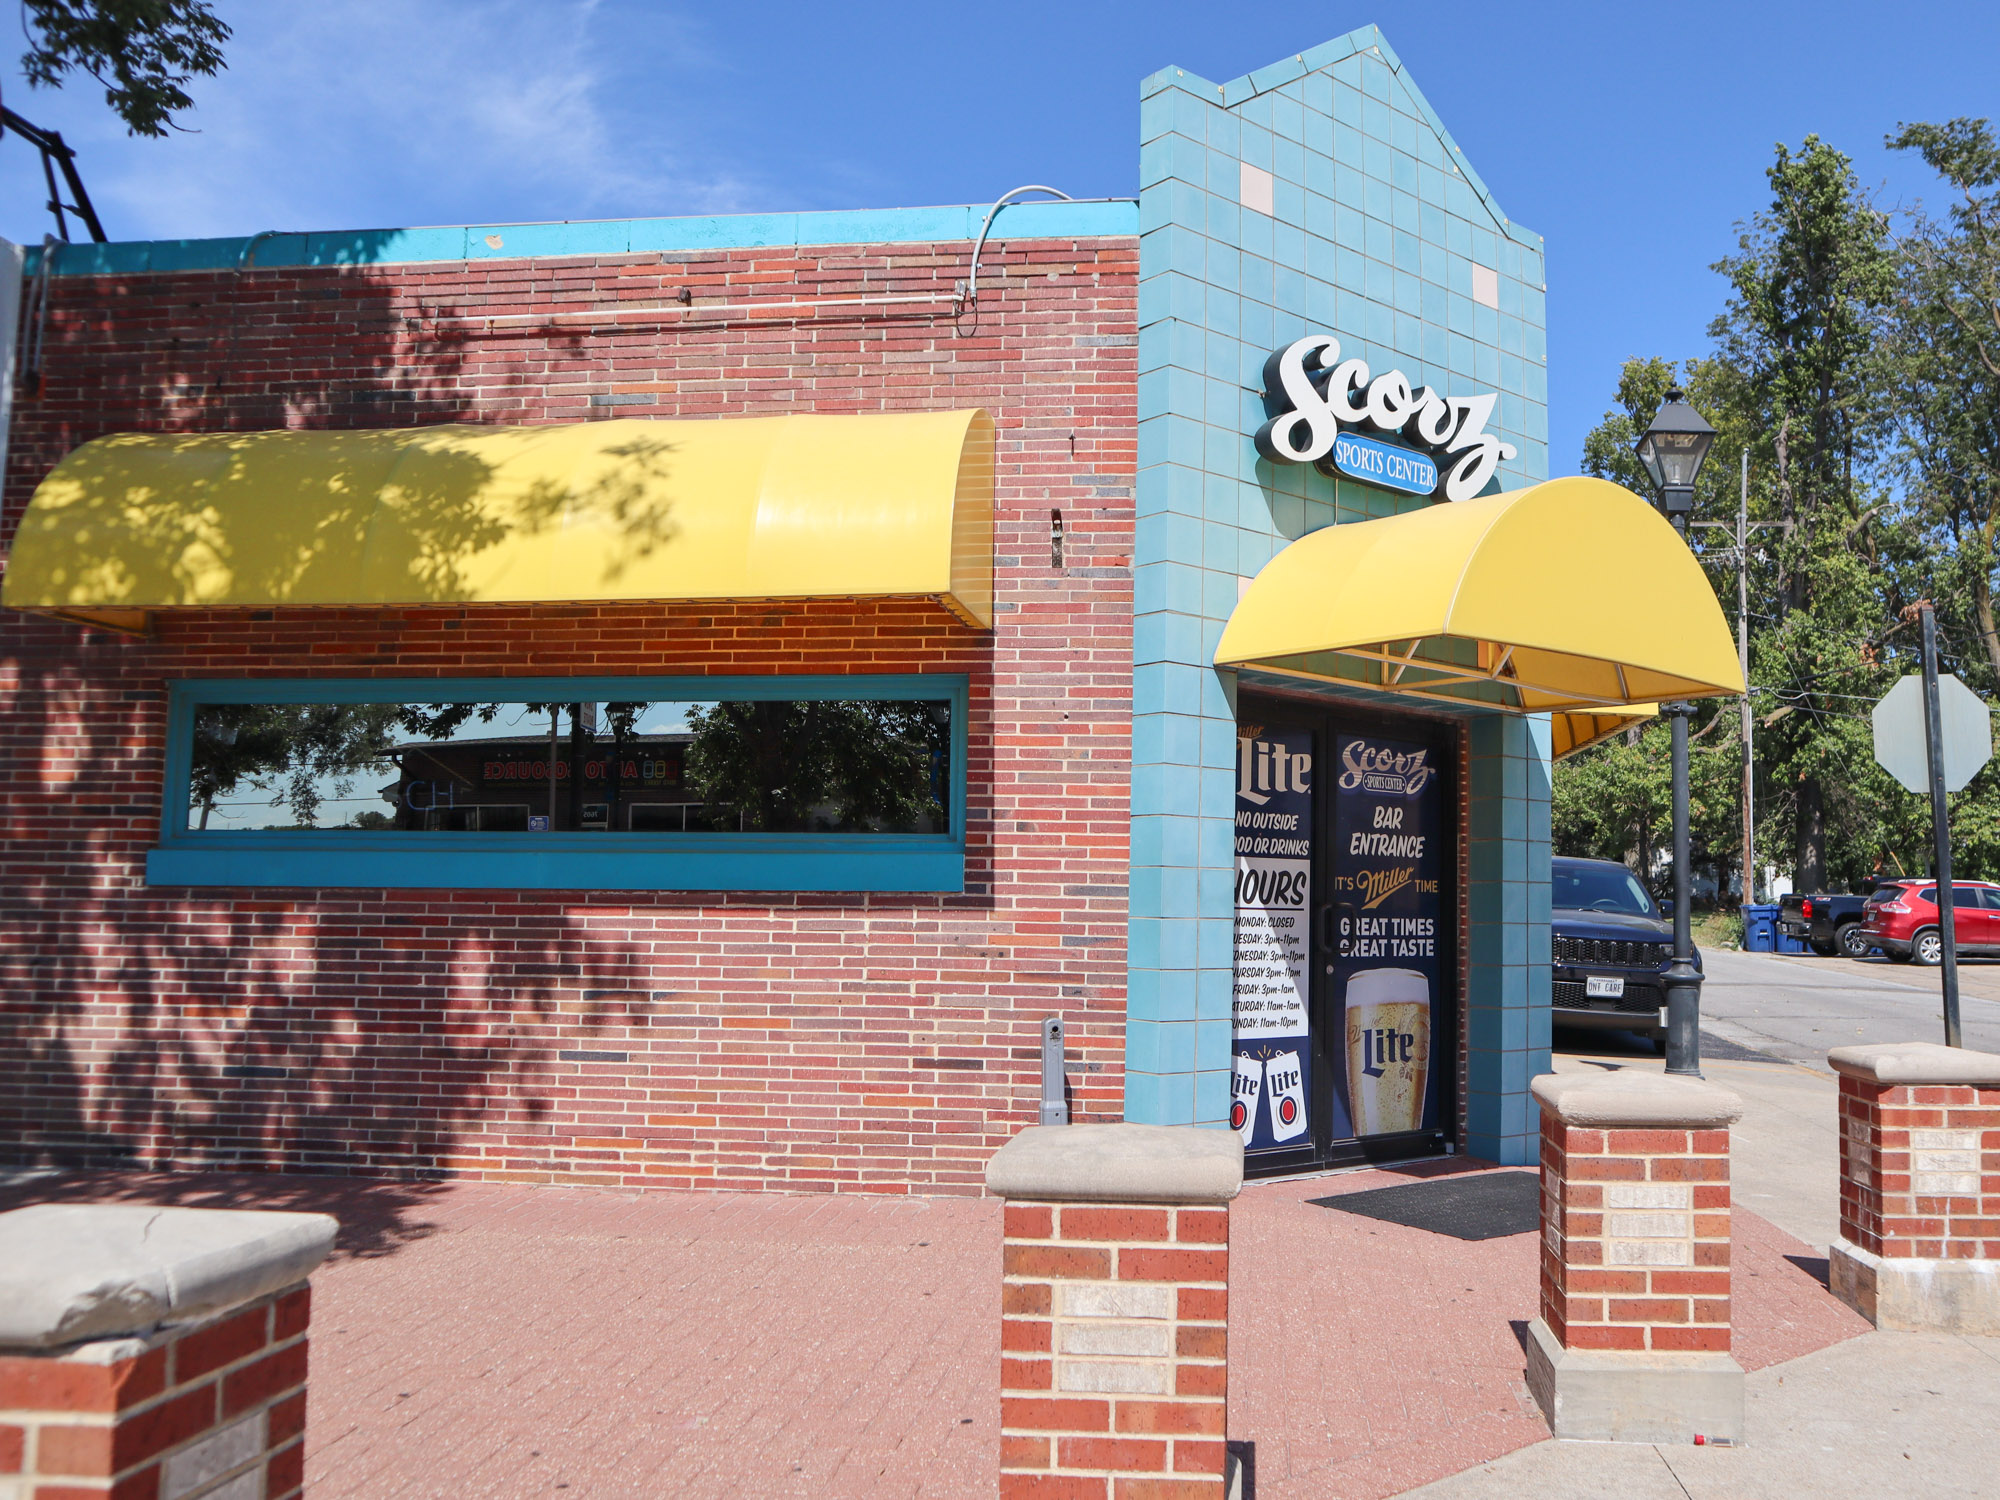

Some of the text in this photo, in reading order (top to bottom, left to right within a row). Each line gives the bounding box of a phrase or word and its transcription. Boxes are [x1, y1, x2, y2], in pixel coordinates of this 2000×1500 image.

[1270, 334, 1517, 502] Scorz
[1335, 440, 1435, 488] SPORTS CENTER
[1237, 725, 1264, 738] iller
[1236, 737, 1312, 805] Lite
[1338, 740, 1436, 795] Scorz
[1367, 776, 1403, 790] SPORTS CENTER
[1235, 810, 1299, 831] NO OUTSIDE
[1373, 805, 1404, 829] BAR
[1253, 837, 1270, 854] OR
[1269, 838, 1310, 856] DRINKS
[1349, 832, 1426, 858] ENTRANCE
[1334, 866, 1439, 904] IT'S Miller TIME
[1234, 917, 1295, 928] MONDAY: CLOSED
[1340, 917, 1434, 936] GREAT TIMES
[1233, 933, 1300, 947] UESDAY: 3pm-11pm
[1339, 938, 1435, 957] GREAT TASTE
[1233, 950, 1305, 963] DNESDAY: 3pm-11pm
[1265, 967, 1301, 980] 3pm-11pm
[1232, 984, 1294, 997] FRIDAY: 3pm-1am
[1604, 983, 1622, 993] CARE
[1267, 1000, 1300, 1011] 11am-1am
[1232, 1016, 1298, 1029] UNDAY: 11am-10pm
[1362, 1028, 1414, 1079] Lite
[1231, 1072, 1258, 1098] Lite
[1270, 1069, 1298, 1098] Lite
